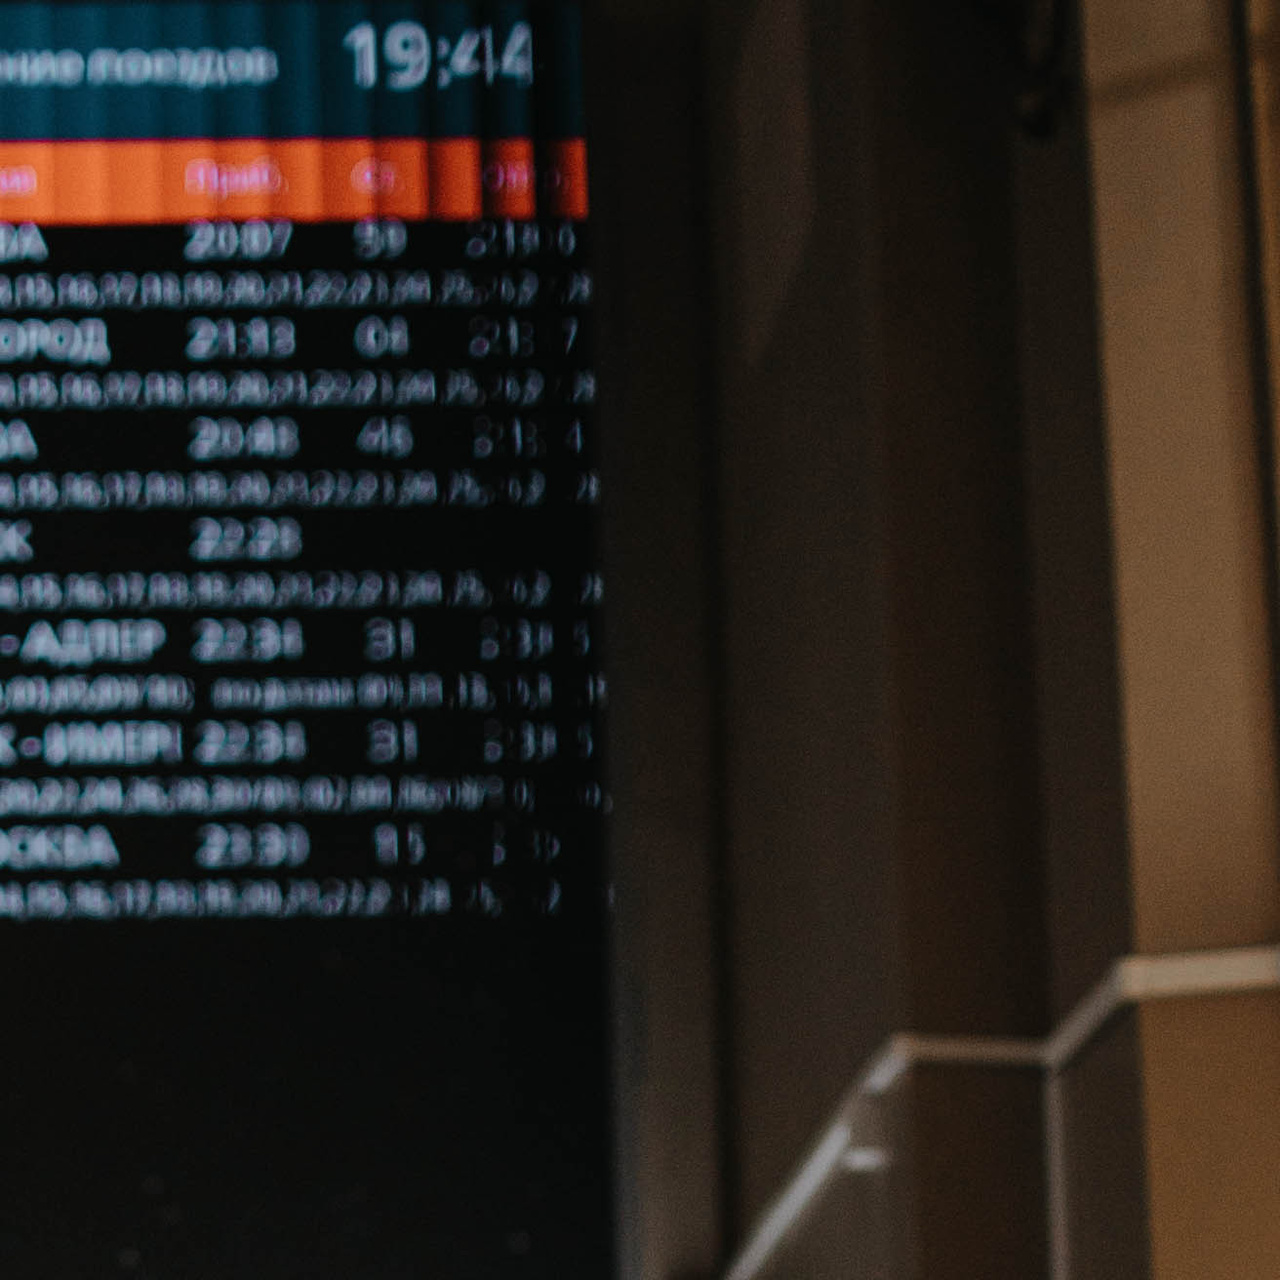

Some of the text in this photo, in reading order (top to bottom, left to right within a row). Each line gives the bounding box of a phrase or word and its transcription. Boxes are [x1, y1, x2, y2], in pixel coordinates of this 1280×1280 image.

[87, 46, 278, 90] поездов
[344, 20, 534, 91] 19:44
[20, 618, 166, 666] АДЛЕР
